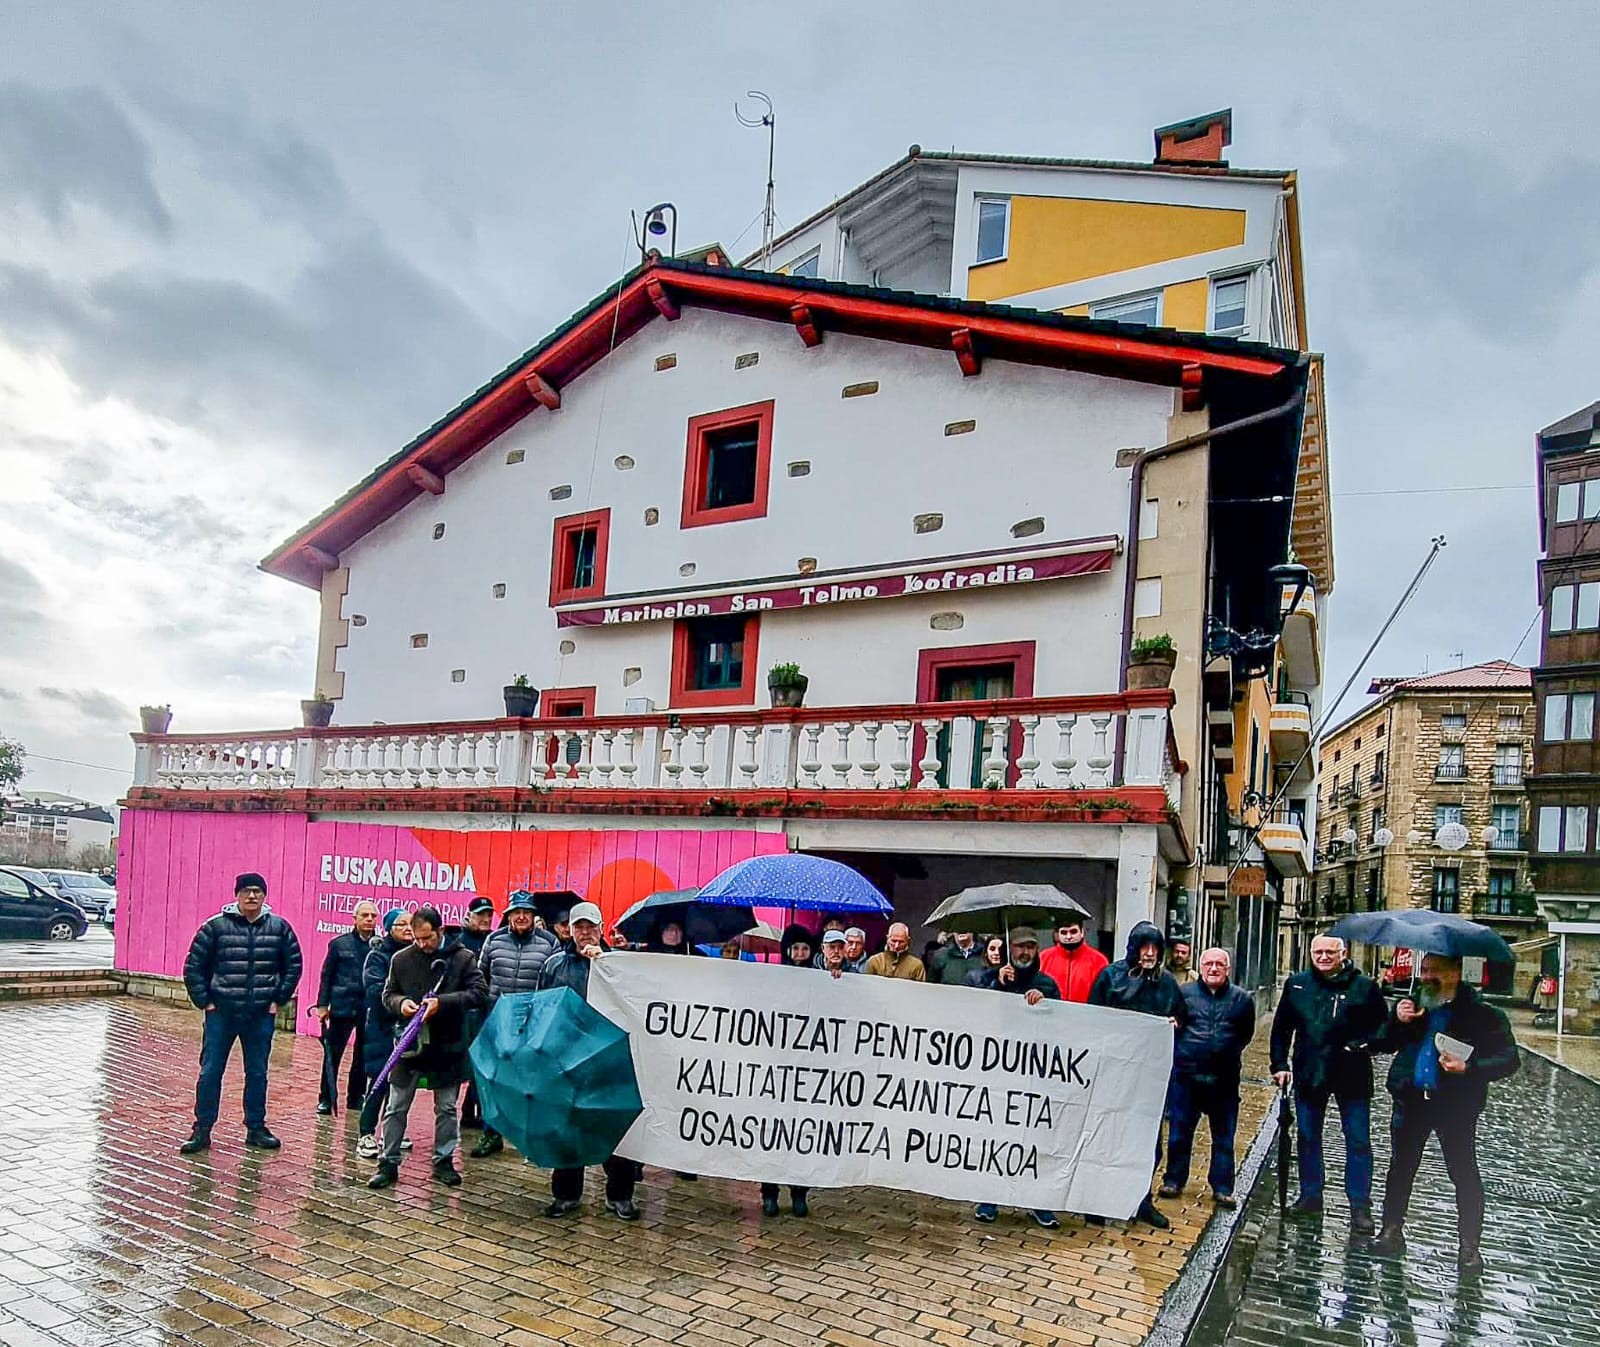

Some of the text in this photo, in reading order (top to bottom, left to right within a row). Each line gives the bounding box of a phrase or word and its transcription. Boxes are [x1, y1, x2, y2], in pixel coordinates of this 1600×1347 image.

[602, 565, 1035, 624] Marinelen San Telmo Kofradia
[320, 854, 477, 893] EUSKARALDIA
[645, 1001, 1091, 1090] GUZTIONTZAT PENTSIO DUINAK,
[676, 1057, 1052, 1129] KALITATEZKO ZAINTZA ETA
[679, 1107, 1038, 1179] OSASUNGINTZA PUBLIKOA
